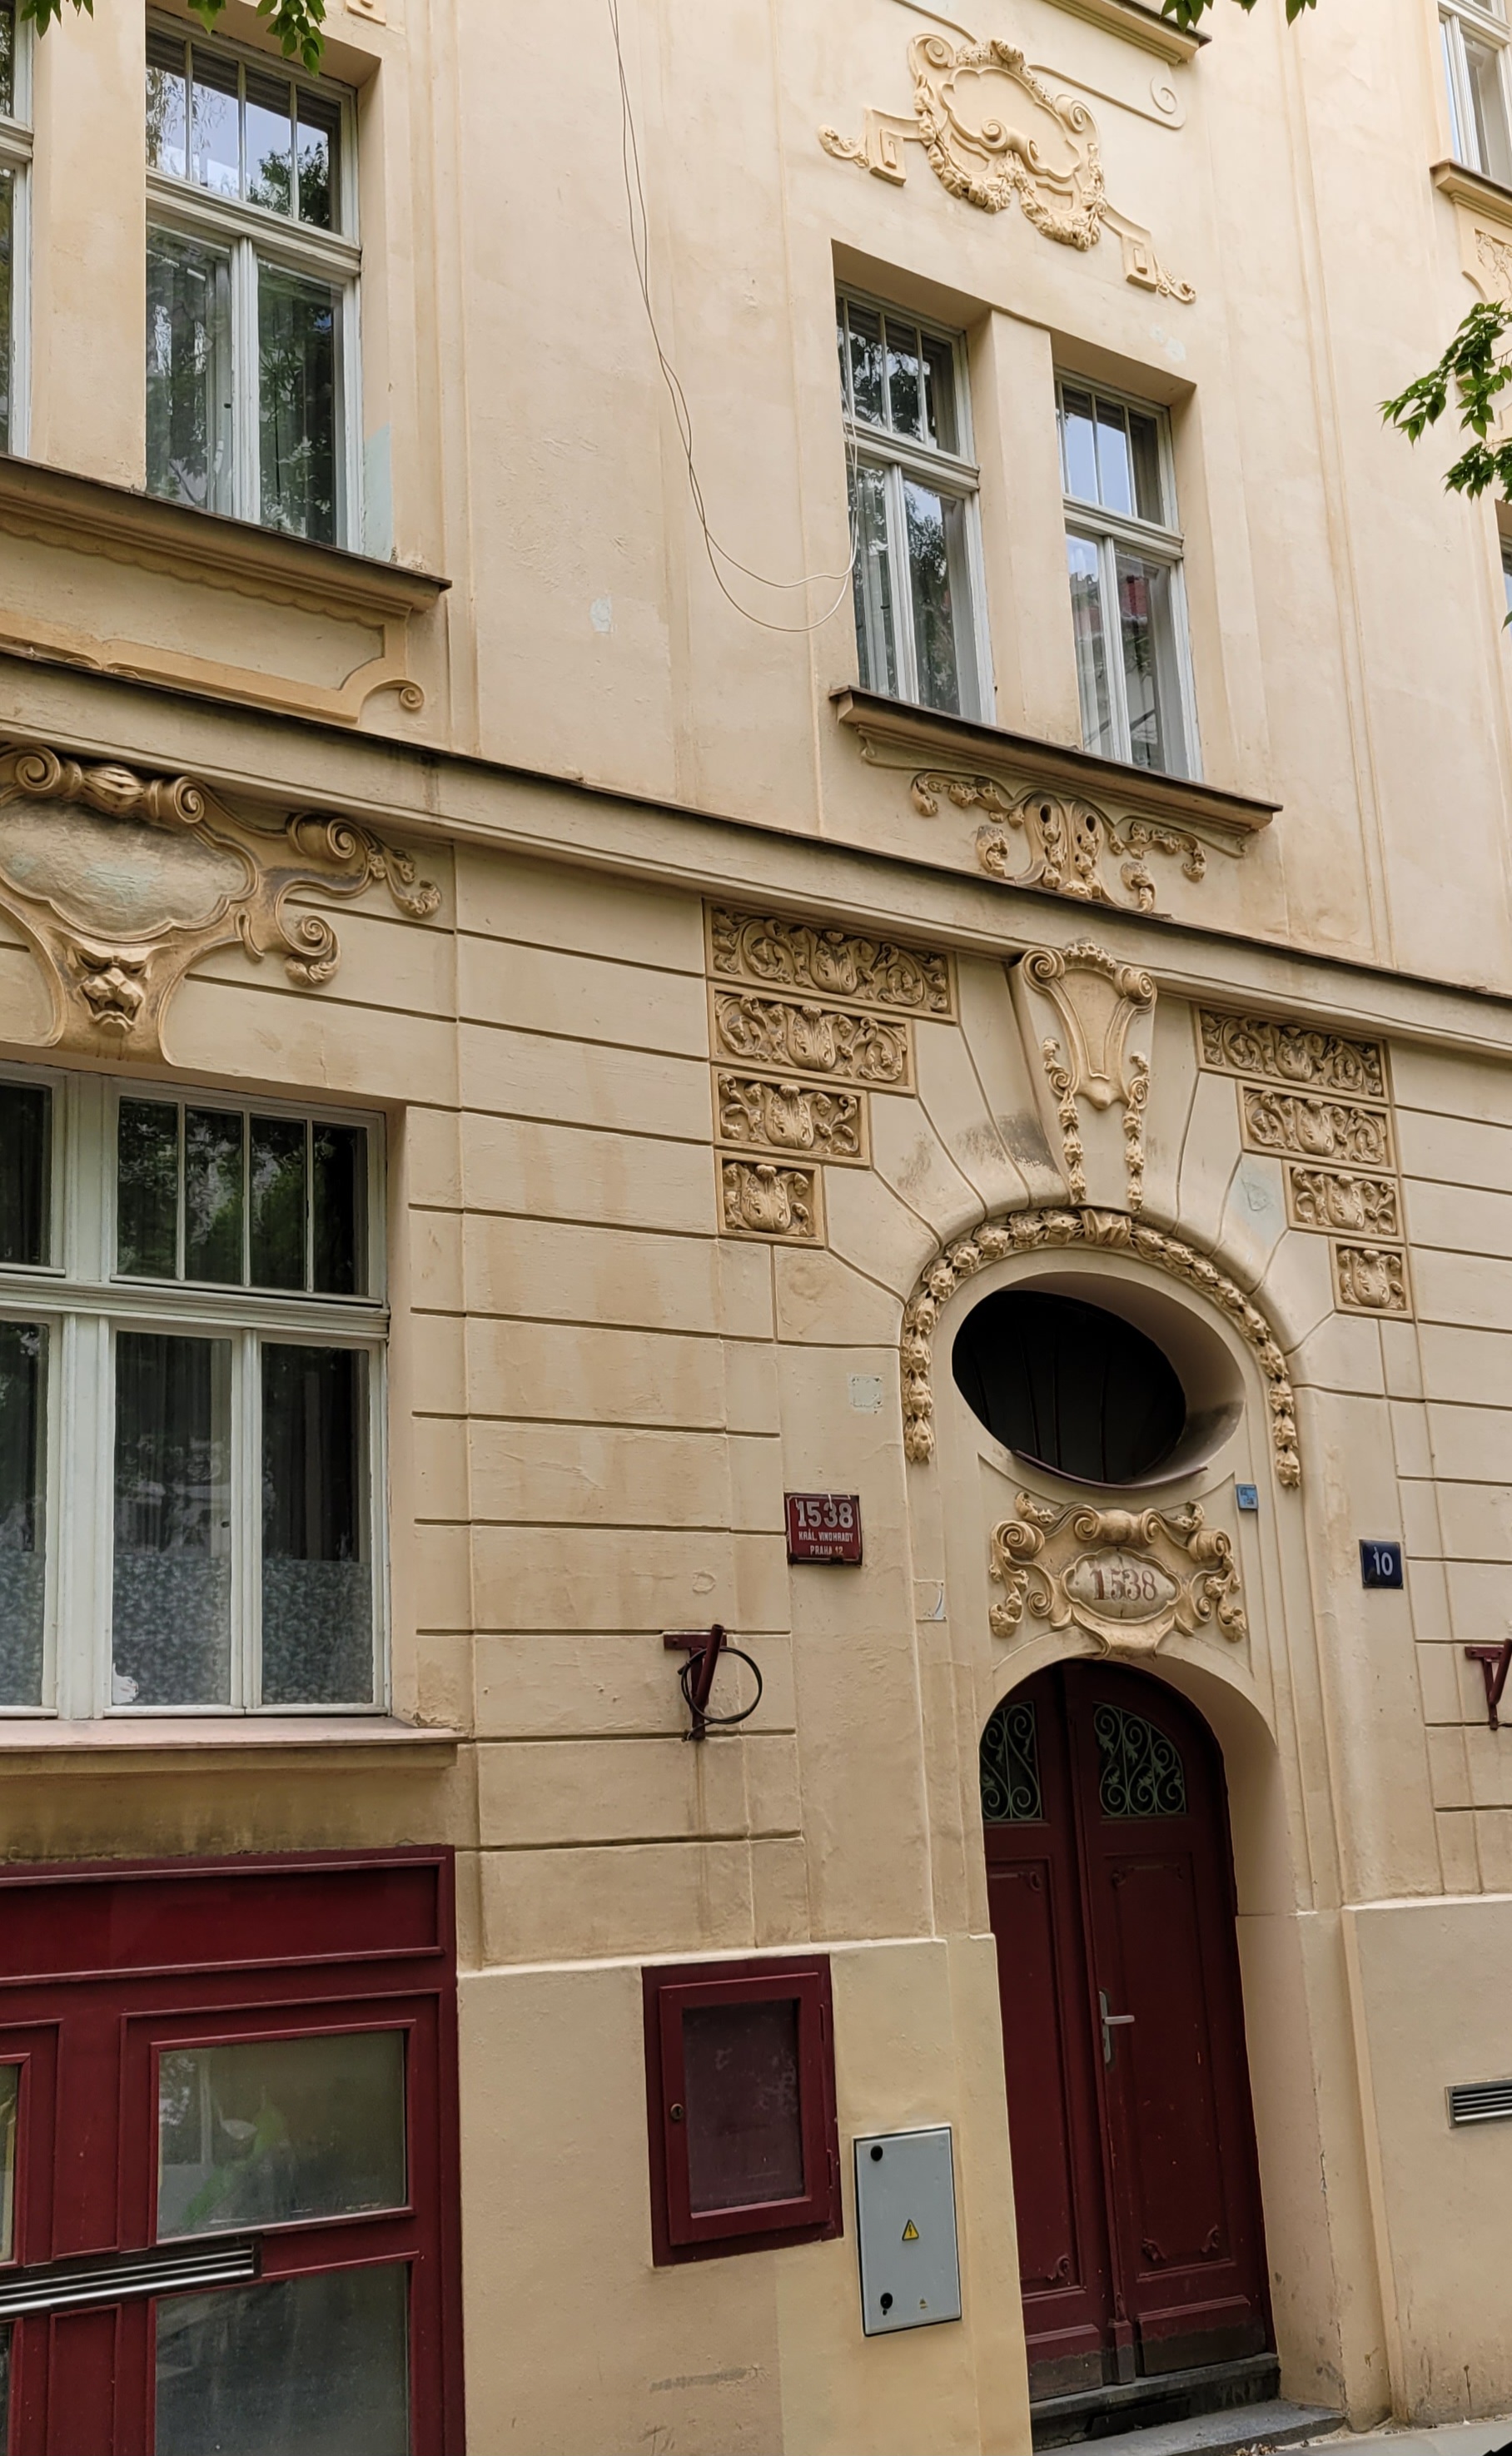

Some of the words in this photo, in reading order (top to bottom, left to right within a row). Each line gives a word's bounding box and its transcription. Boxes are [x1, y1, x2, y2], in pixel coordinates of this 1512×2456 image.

[797, 1501, 853, 1529] 1538
[798, 1529, 818, 1541] KRÁL.
[818, 1532, 853, 1543] VINOHRADY
[810, 1545, 833, 1556] PRAHA
[835, 1546, 844, 1556] 12
[1373, 1551, 1393, 1576] 10
[1090, 1569, 1157, 1601] 1538
